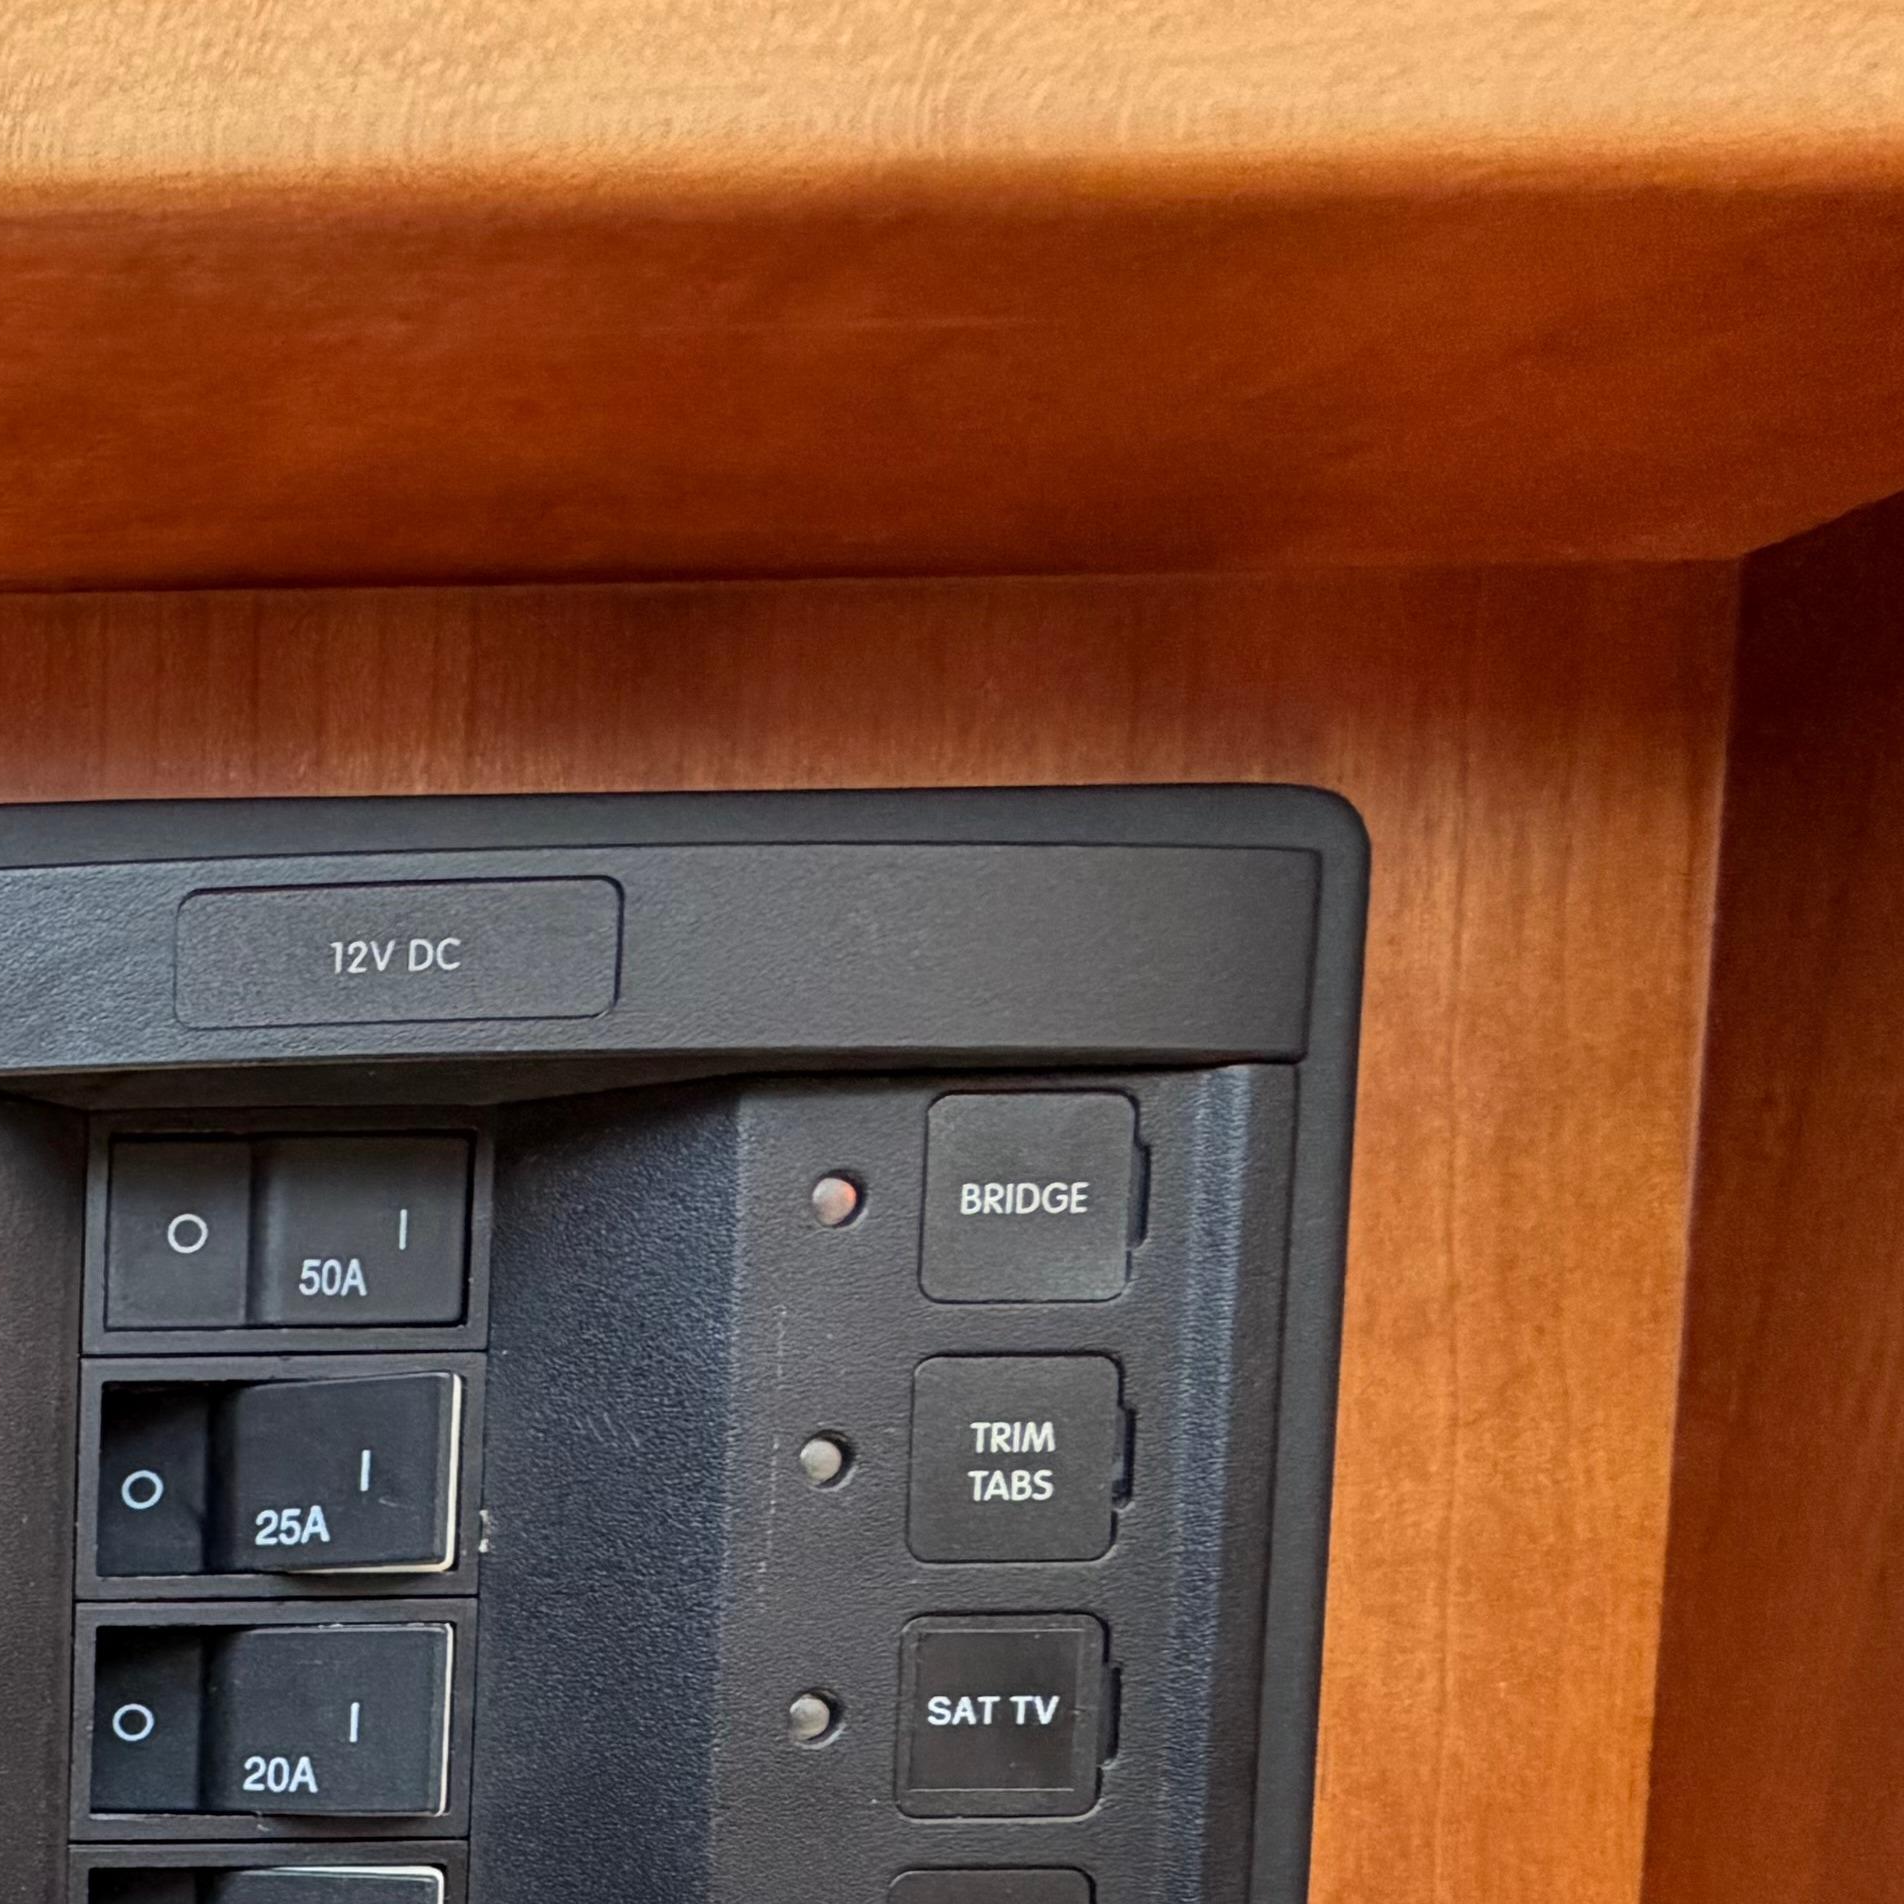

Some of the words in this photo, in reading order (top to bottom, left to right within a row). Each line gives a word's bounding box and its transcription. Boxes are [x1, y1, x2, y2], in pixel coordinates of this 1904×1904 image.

[330, 940, 396, 974] 12V
[407, 937, 461, 972] DC
[960, 1181, 1090, 1215] BRIDGE
[298, 1258, 367, 1297] 50A
[969, 1421, 1056, 1454] TRIM
[967, 1469, 1054, 1502] TABS
[255, 1504, 331, 1546] 25A
[927, 1695, 1001, 1726] SAT
[1009, 1695, 1060, 1725] TV
[242, 1756, 319, 1794] 20A
